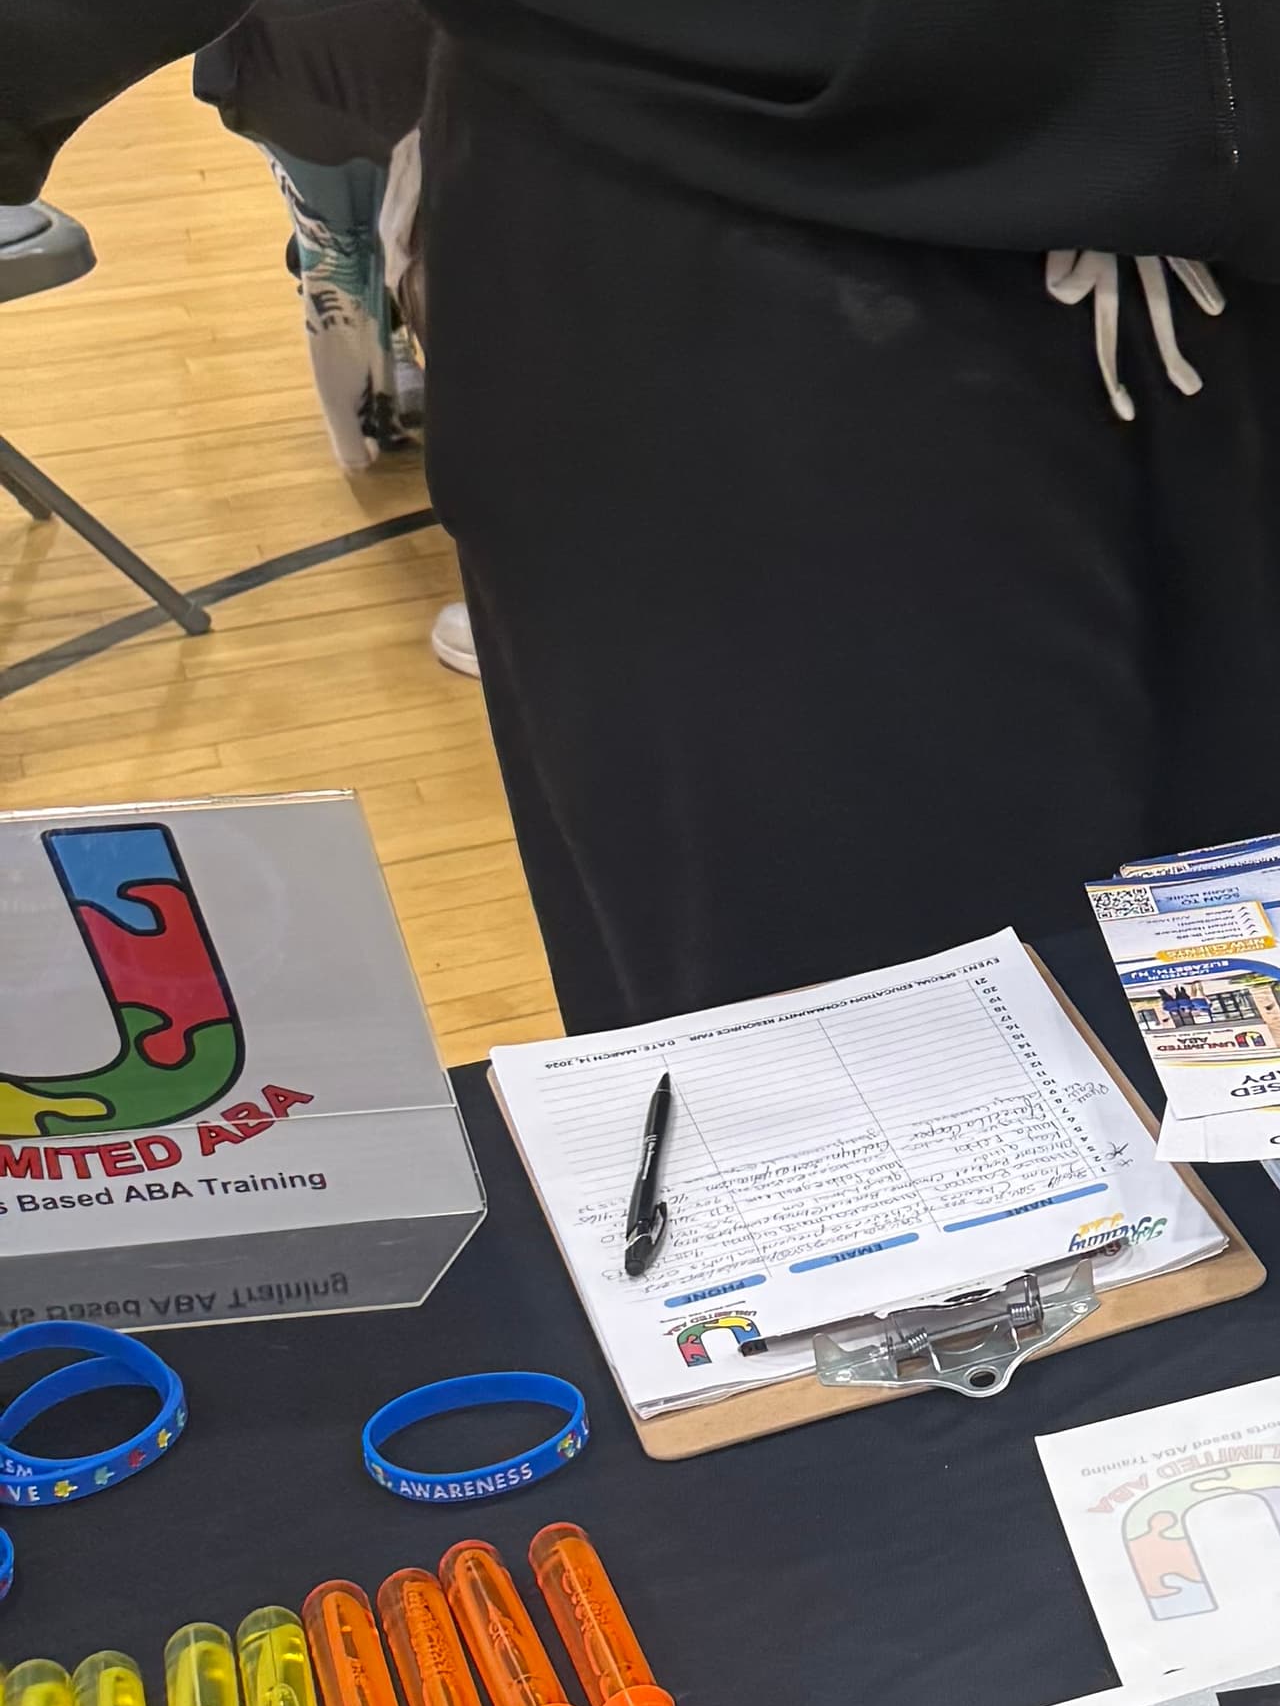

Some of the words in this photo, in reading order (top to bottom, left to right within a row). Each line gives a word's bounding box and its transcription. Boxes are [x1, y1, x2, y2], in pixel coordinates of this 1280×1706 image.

[1180, 898, 1198, 906] TO
[1203, 891, 1239, 902] SCAN
[1130, 970, 1148, 979] NJ
[1151, 957, 1228, 977] ELIZABETH,
[848, 982, 913, 1004] EDUCATION
[776, 999, 847, 1022] COMMUNITY
[689, 1031, 712, 1041] FAIR
[716, 1017, 774, 1036] RESOURCE
[1157, 1038, 1235, 1053] UNLIMITED
[1176, 1034, 1209, 1047] ABA
[592, 1047, 636, 1061] MARCH
[0, 1135, 182, 1180] MITED
[197, 1084, 314, 1156] ABA
[18, 1187, 114, 1214] Based
[125, 1180, 194, 1204] ABA
[198, 1171, 327, 1198] Training
[1004, 1197, 1053, 1217] NAME
[830, 1243, 883, 1262] EMAIL
[1191, 1429, 1244, 1453] Based
[1152, 1443, 1188, 1462] ABA
[1080, 1451, 1147, 1480] Training
[398, 1460, 534, 1501] AWARENESS
[1086, 1473, 1150, 1517] ABA
